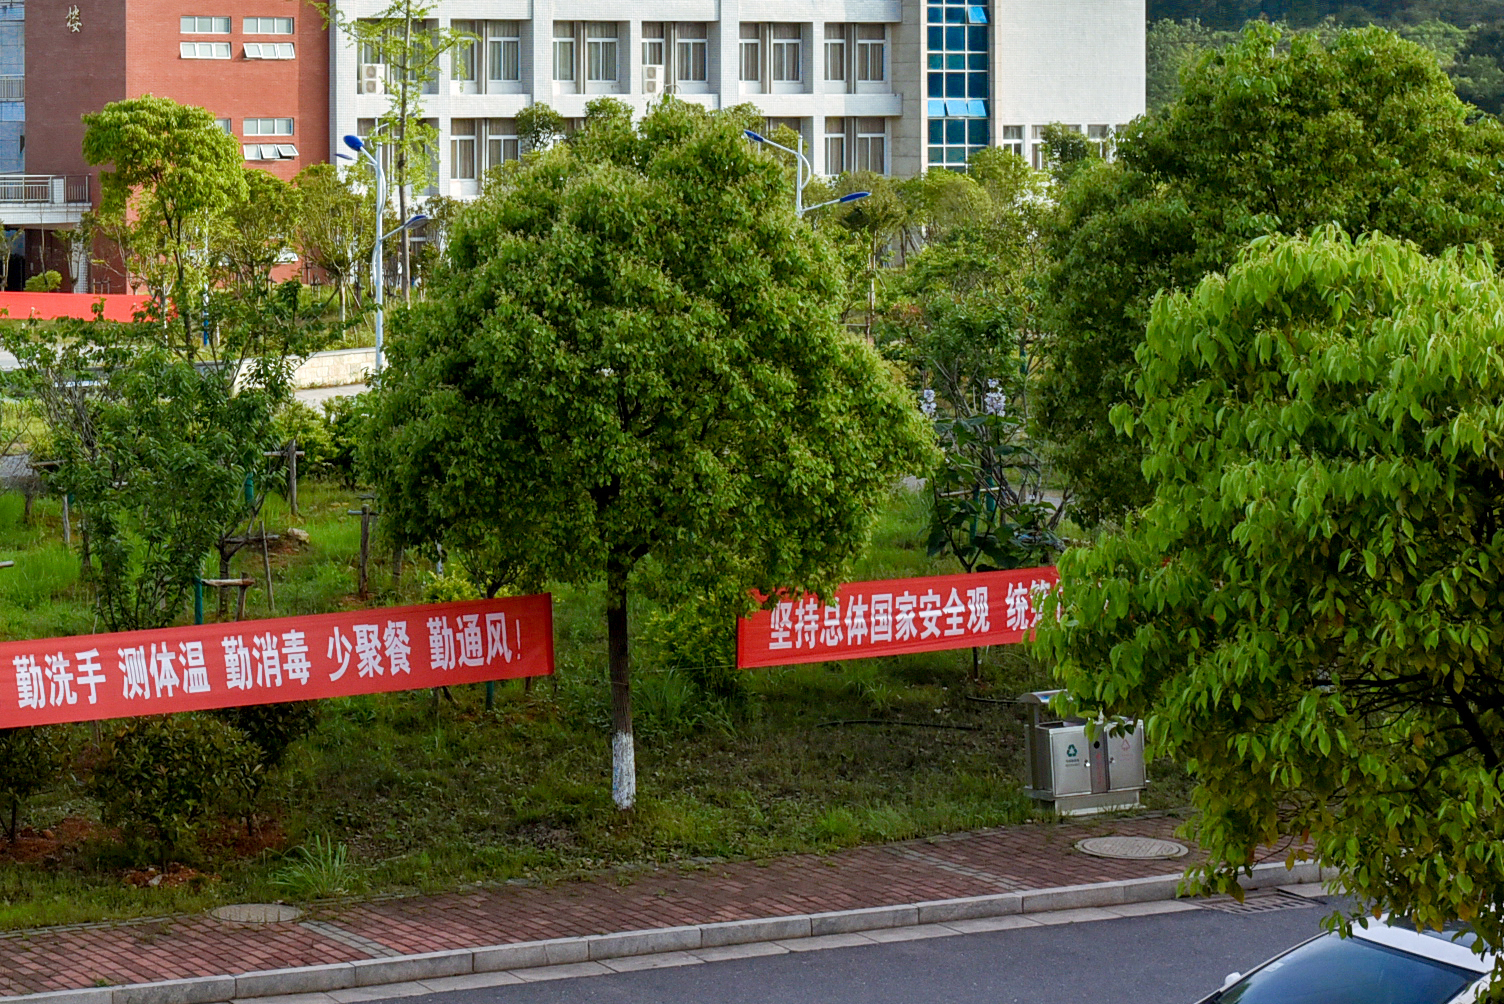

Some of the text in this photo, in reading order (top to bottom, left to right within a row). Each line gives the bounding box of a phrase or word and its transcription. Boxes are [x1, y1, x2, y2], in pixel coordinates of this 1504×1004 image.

[768, 586, 991, 650] 坚持总体国家安全观
[11, 647, 107, 710] 勤洗手
[117, 640, 211, 700] 测体温
[220, 628, 312, 691] 勤消毒
[326, 620, 411, 682] 少聚餐
